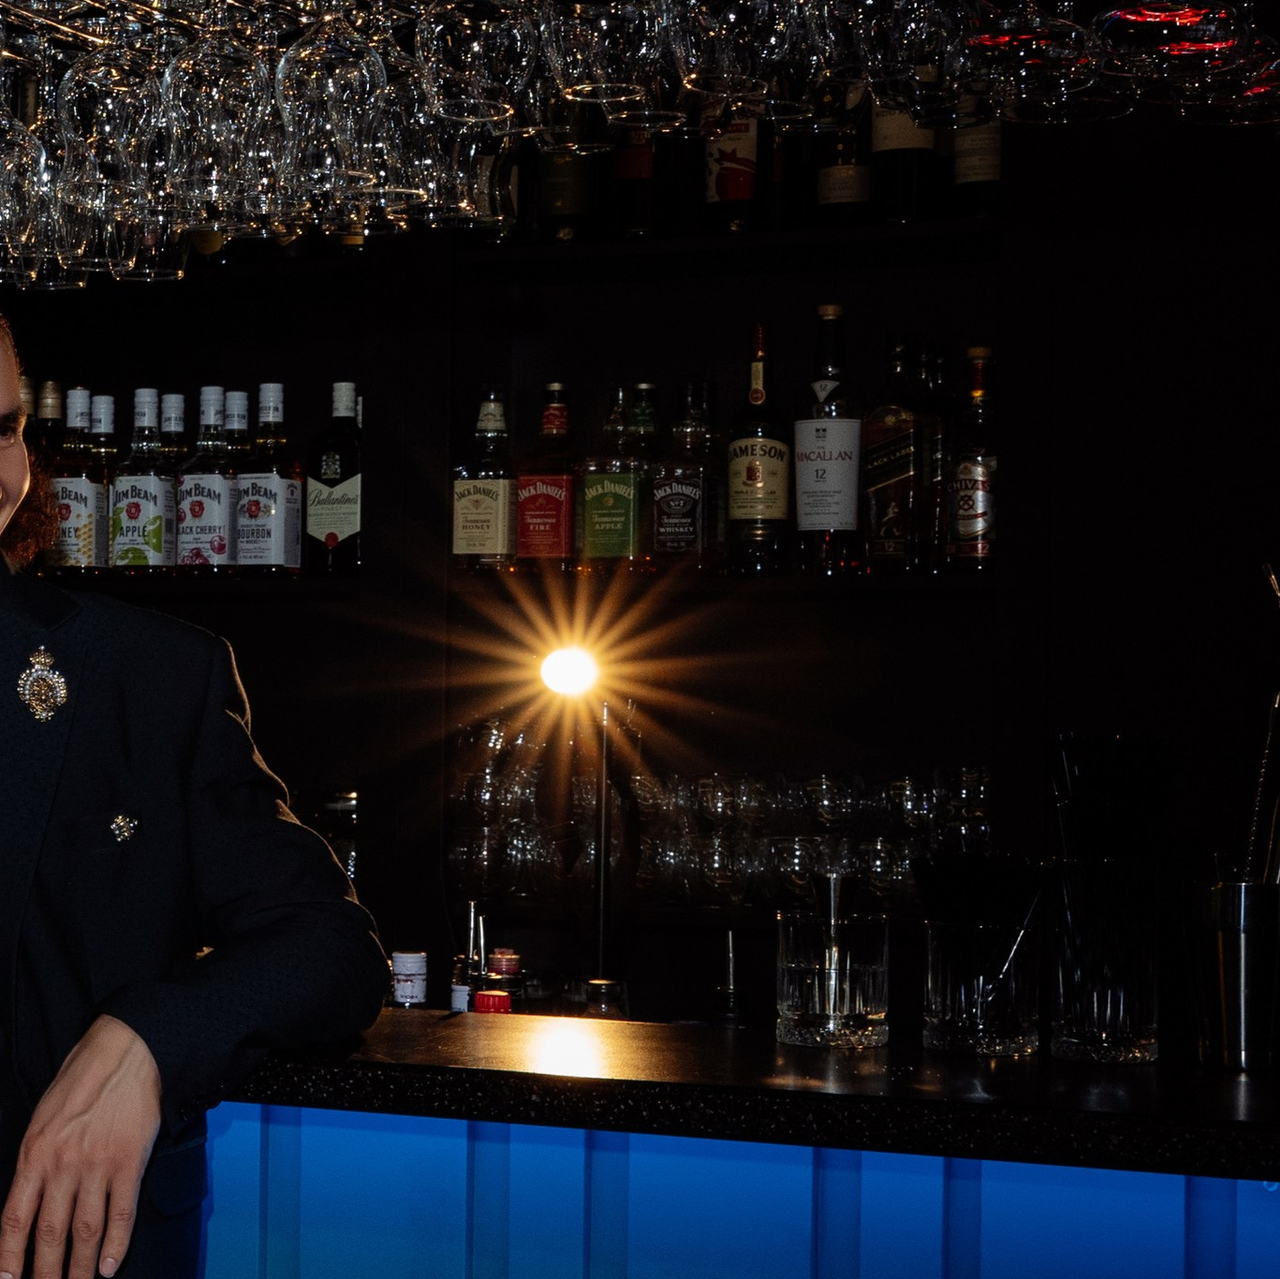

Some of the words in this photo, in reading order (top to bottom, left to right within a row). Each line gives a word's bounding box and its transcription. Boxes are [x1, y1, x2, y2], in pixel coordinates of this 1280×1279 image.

[796, 451, 853, 462] MACALLAN
[814, 469, 827, 480] 12
[178, 487, 193, 505] JIM
[194, 483, 221, 505] BEAM
[251, 482, 278, 505] BEAM
[455, 487, 473, 502] JACK
[473, 484, 500, 502] DANIEL'S
[518, 485, 536, 502] JACK
[536, 481, 566, 502] DANIEL'S
[585, 484, 604, 501] JACK
[653, 485, 672, 501] JACK
[672, 482, 700, 500] DANIEL'S
[947, 480, 991, 492] CHIVAS
[61, 486, 88, 509] BEAM
[113, 489, 129, 508] JIM
[130, 485, 158, 507] BEAM
[308, 488, 359, 507] Ballantine's
[119, 525, 148, 538] APPLE
[177, 525, 194, 535] LACK
[195, 525, 221, 535] CHERRY
